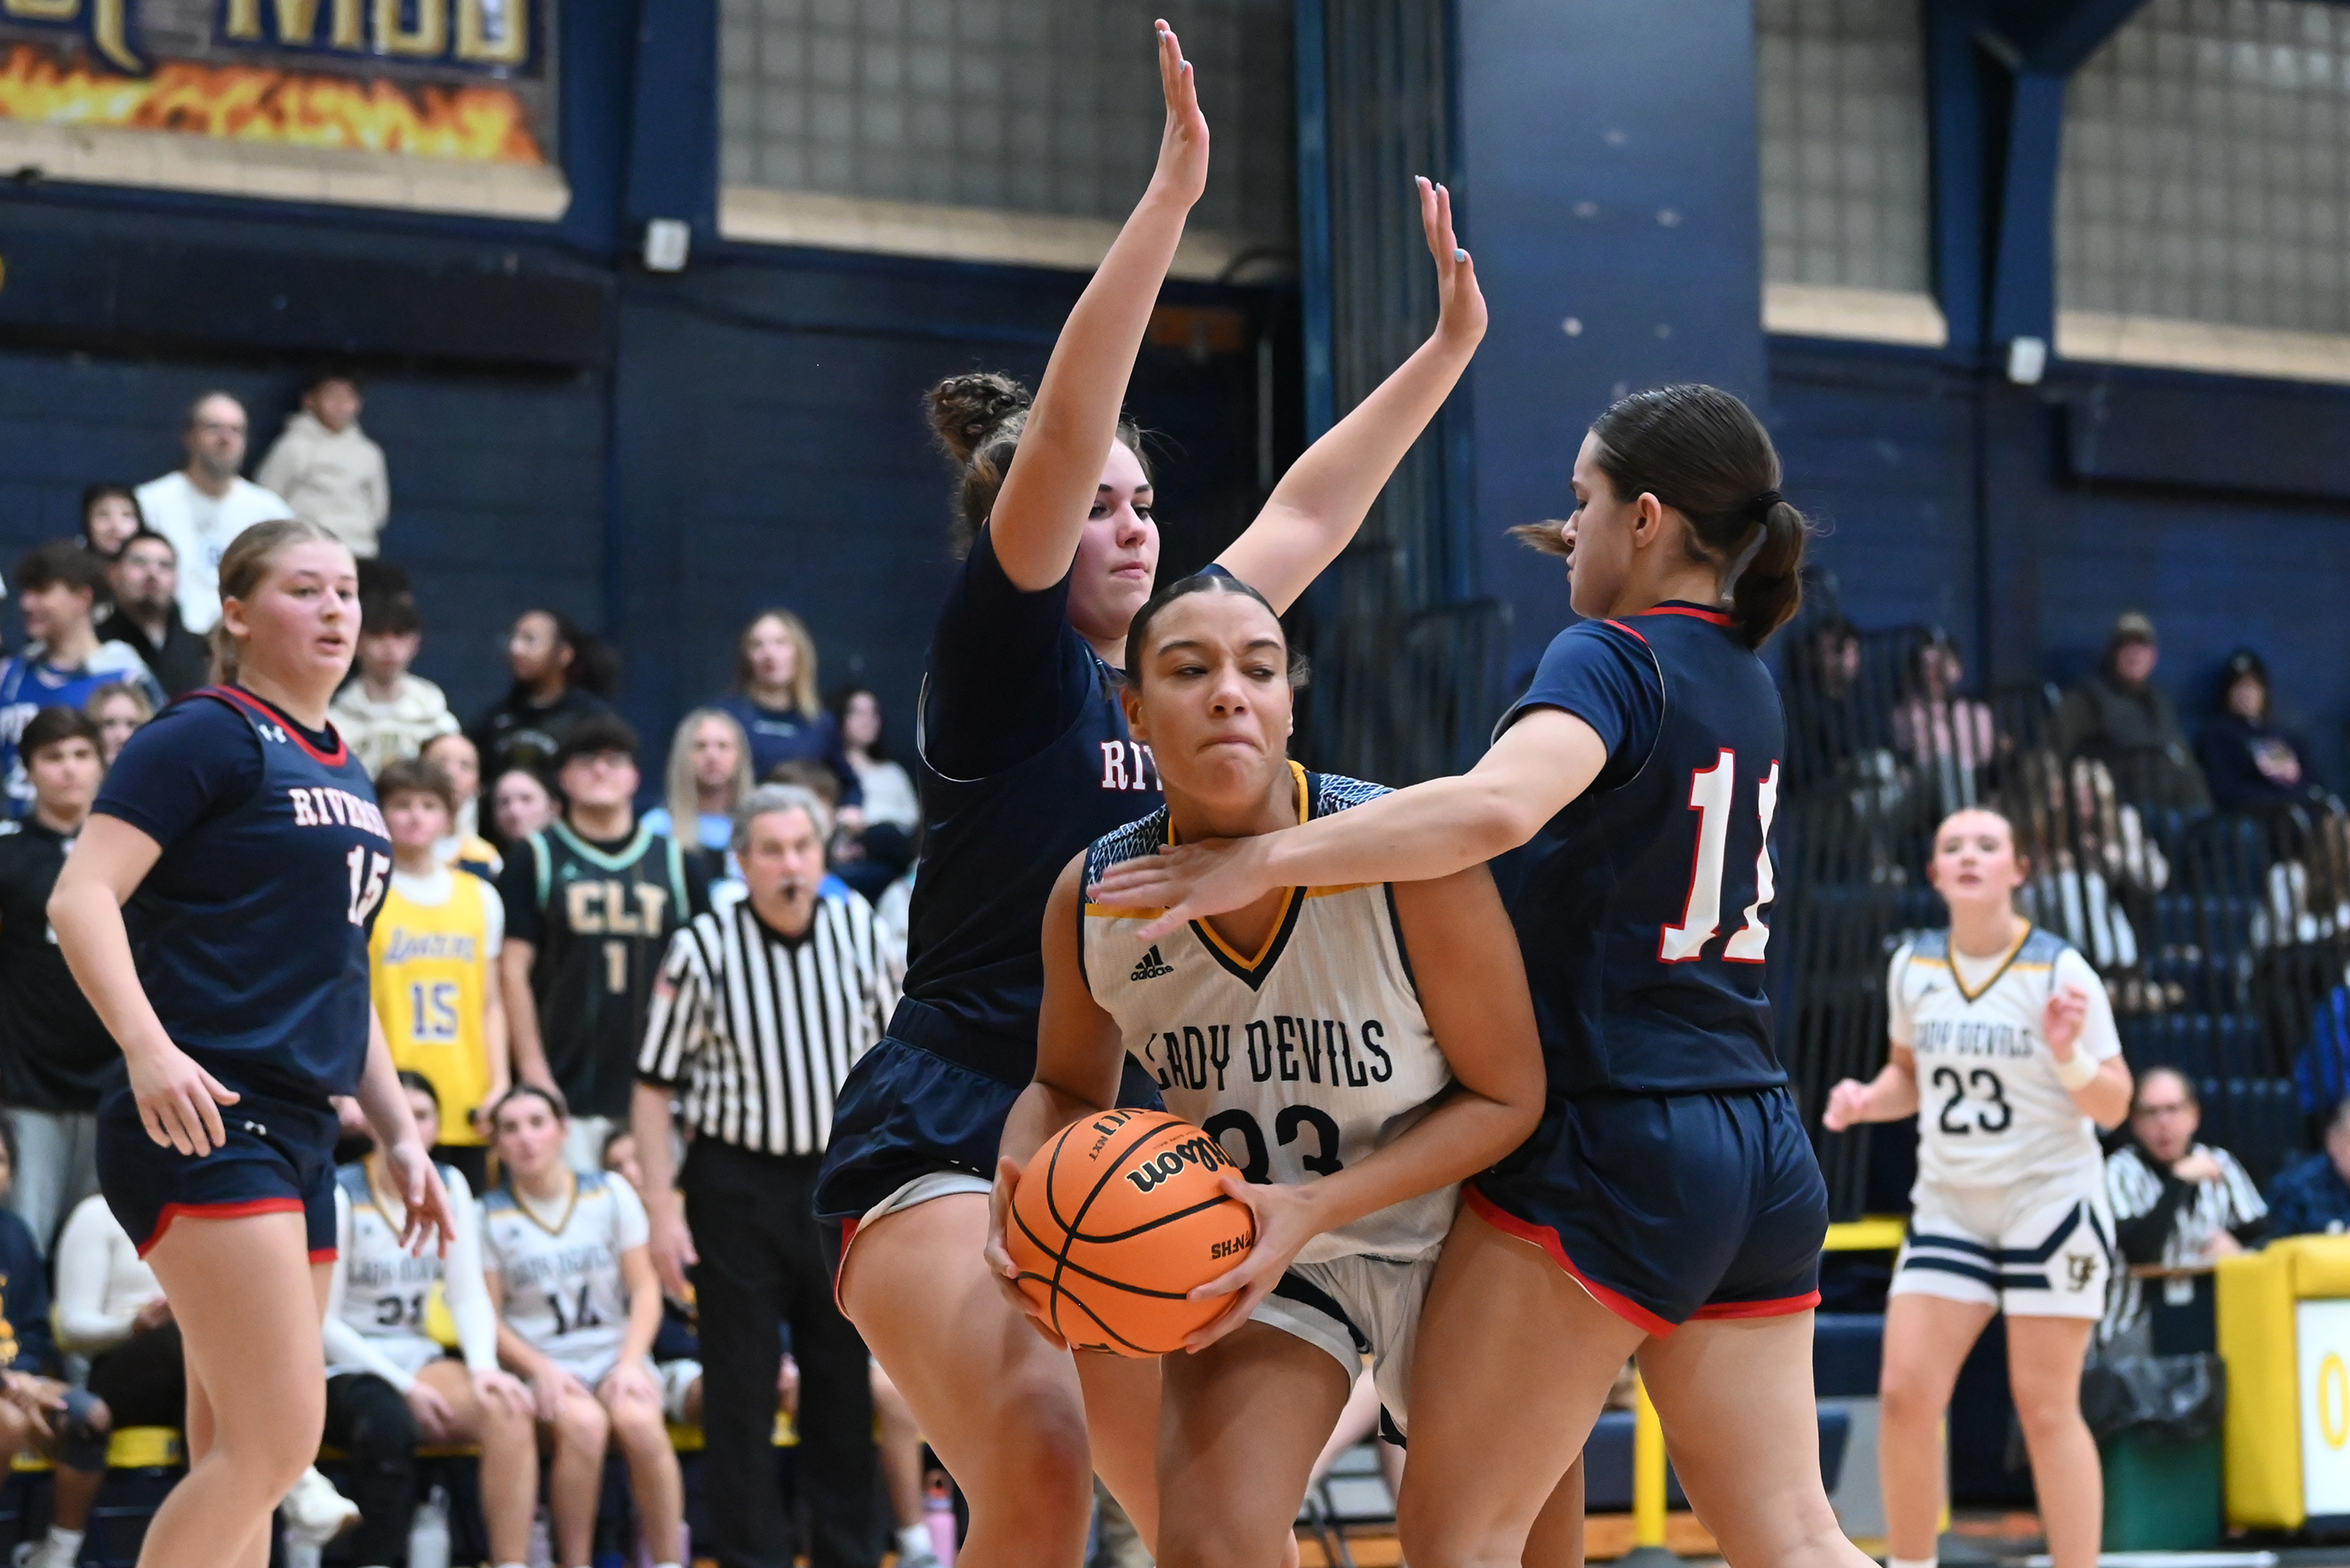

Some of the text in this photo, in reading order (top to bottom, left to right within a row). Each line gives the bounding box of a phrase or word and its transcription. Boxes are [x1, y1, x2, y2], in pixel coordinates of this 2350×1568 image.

[1657, 746, 1780, 964] 11
[346, 844, 391, 927] 15
[566, 880, 668, 938] CLT
[602, 941, 627, 995] 1
[1131, 964, 1174, 981] adidas
[411, 982, 460, 1042] 15
[1145, 1015, 1393, 1091] LADY DEVILS
[1932, 1066, 2012, 1135] 23
[1124, 1136, 1238, 1194] ilson
[1211, 1234, 1245, 1259] NFHS
[548, 1285, 601, 1335] 14
